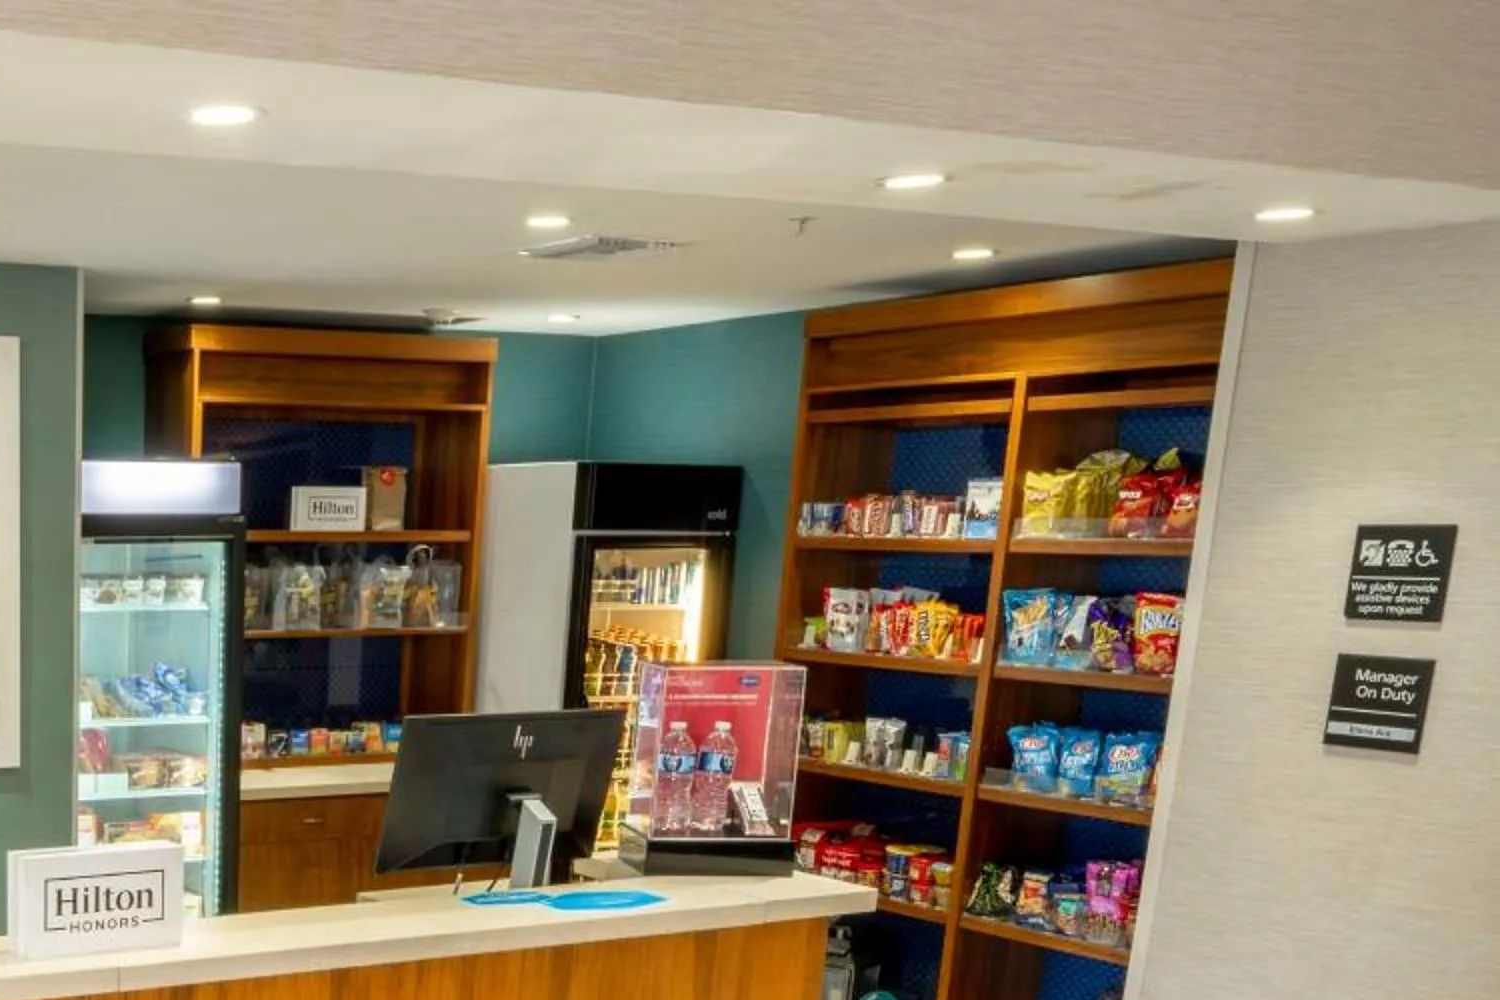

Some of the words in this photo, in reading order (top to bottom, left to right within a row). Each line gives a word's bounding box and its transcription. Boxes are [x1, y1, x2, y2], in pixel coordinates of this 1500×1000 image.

[313, 501, 355, 515] Hilton
[1352, 581, 1367, 591] We
[1369, 581, 1398, 594] gladly
[1400, 583, 1438, 597] provide
[1358, 605, 1384, 615] upon
[1386, 605, 1423, 616] request
[1355, 668, 1419, 687] Manager
[1356, 685, 1377, 699] On
[1381, 687, 1415, 705] Duty
[513, 725, 533, 760] hp
[56, 886, 153, 916] Hilton
[69, 915, 140, 934] HONORS
